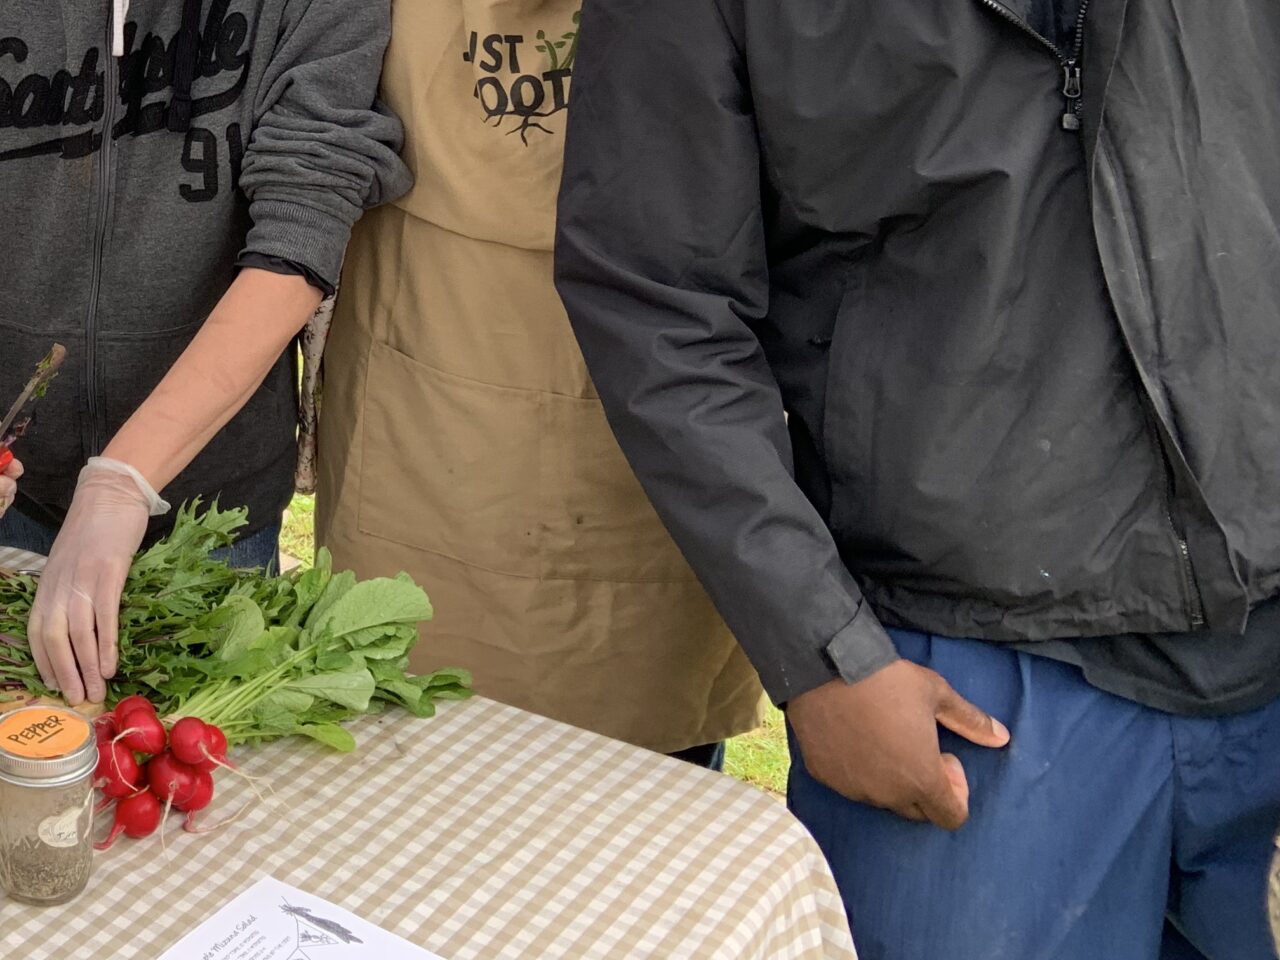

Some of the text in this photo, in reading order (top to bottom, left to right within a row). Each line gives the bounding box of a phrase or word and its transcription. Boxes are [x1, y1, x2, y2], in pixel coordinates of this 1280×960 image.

[463, 31, 523, 74] JST
[474, 68, 572, 117] OOT
[6, 713, 66, 747] PEPPER
